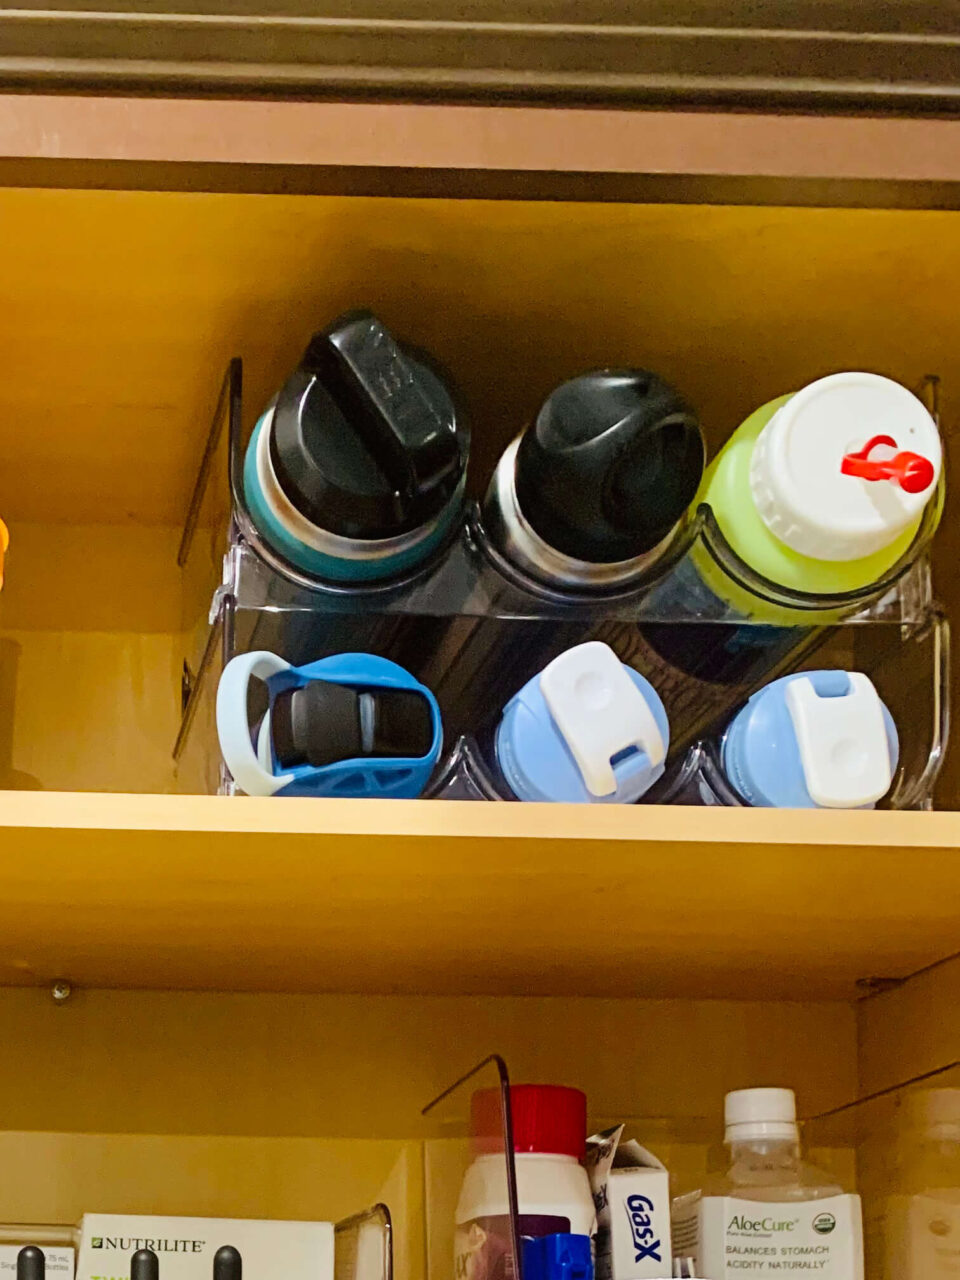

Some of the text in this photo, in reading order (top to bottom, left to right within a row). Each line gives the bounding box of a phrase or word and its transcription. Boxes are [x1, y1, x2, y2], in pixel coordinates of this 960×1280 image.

[627, 1194, 662, 1263] Gas-X
[728, 1215, 794, 1231] AloeCure
[105, 1237, 202, 1252] NUTRILITE
[726, 1246, 829, 1255] BALANCES STOMACH
[727, 1260, 764, 1269] ACIDITY
